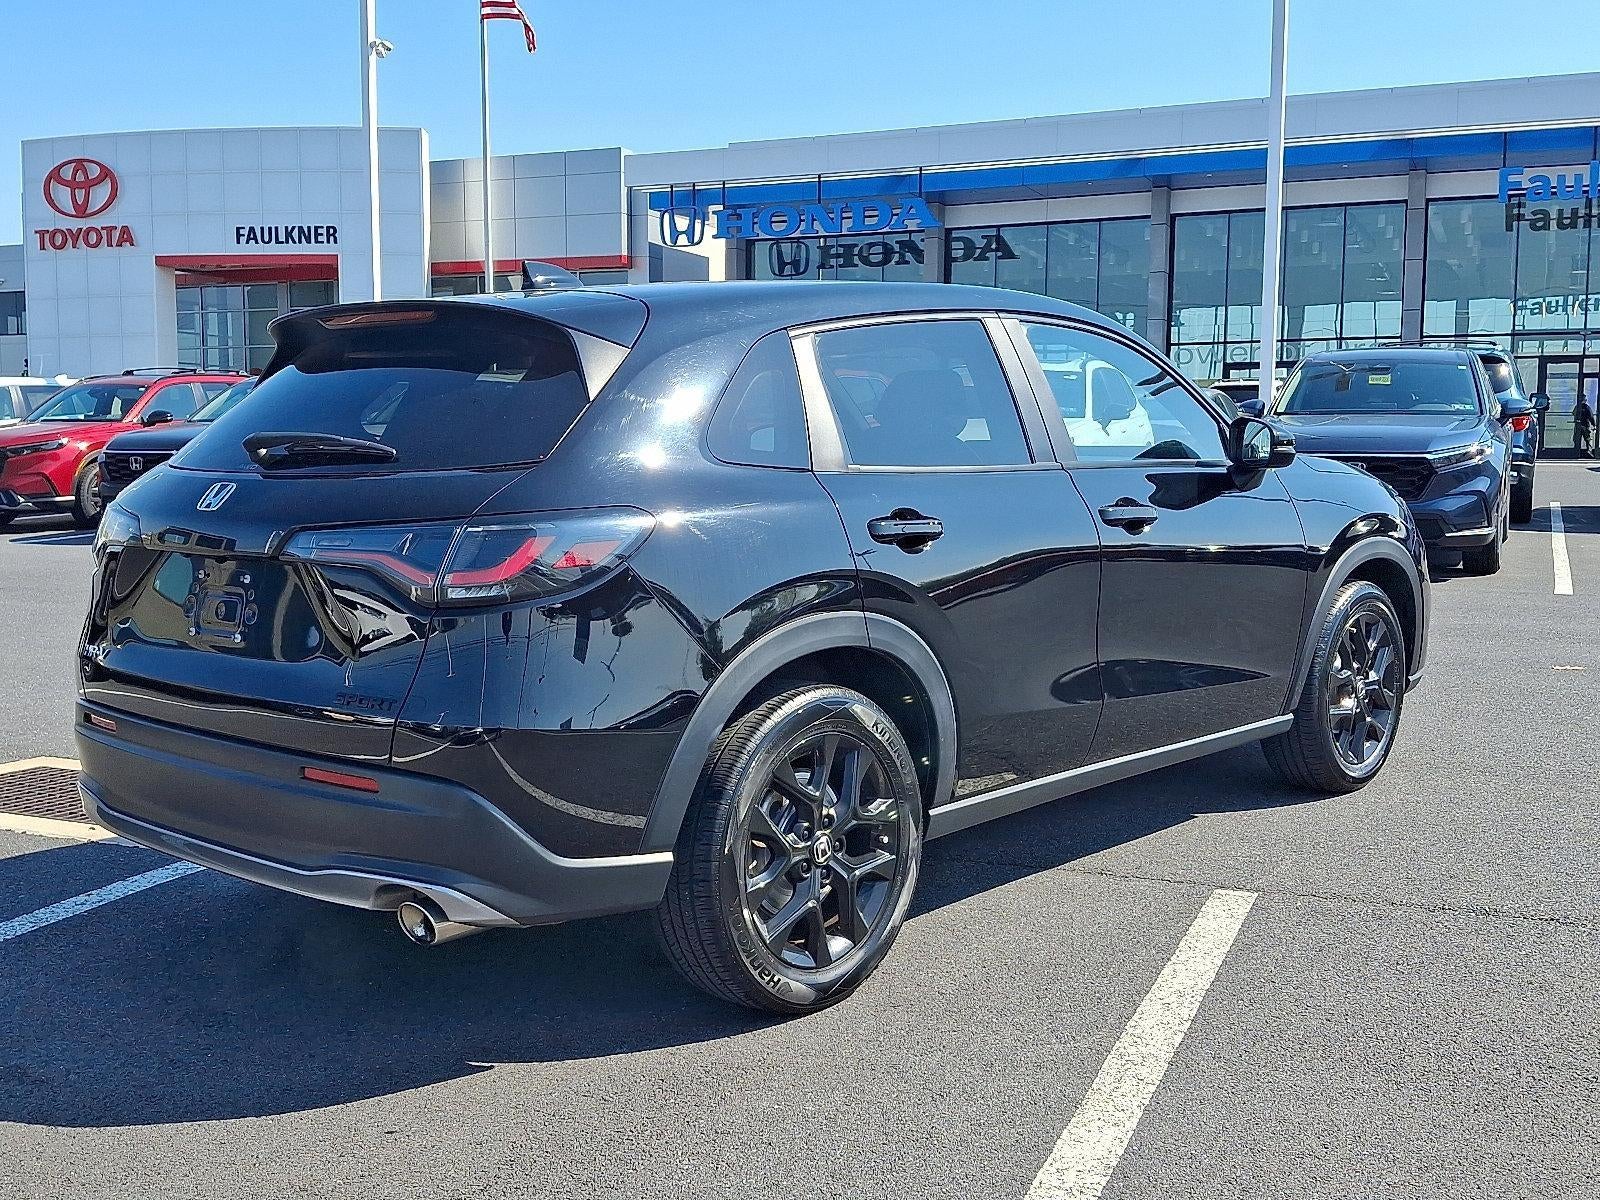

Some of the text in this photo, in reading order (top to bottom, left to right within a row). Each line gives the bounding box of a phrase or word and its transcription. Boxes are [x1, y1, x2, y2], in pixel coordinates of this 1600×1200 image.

[1498, 160, 1600, 203] Faul
[713, 198, 943, 239] HONDA
[1505, 196, 1600, 232] Faul
[35, 225, 135, 251] TOYOTA
[235, 225, 338, 245] FAULKNER
[1173, 345, 1261, 365] ower
[334, 692, 398, 711] SPORT
